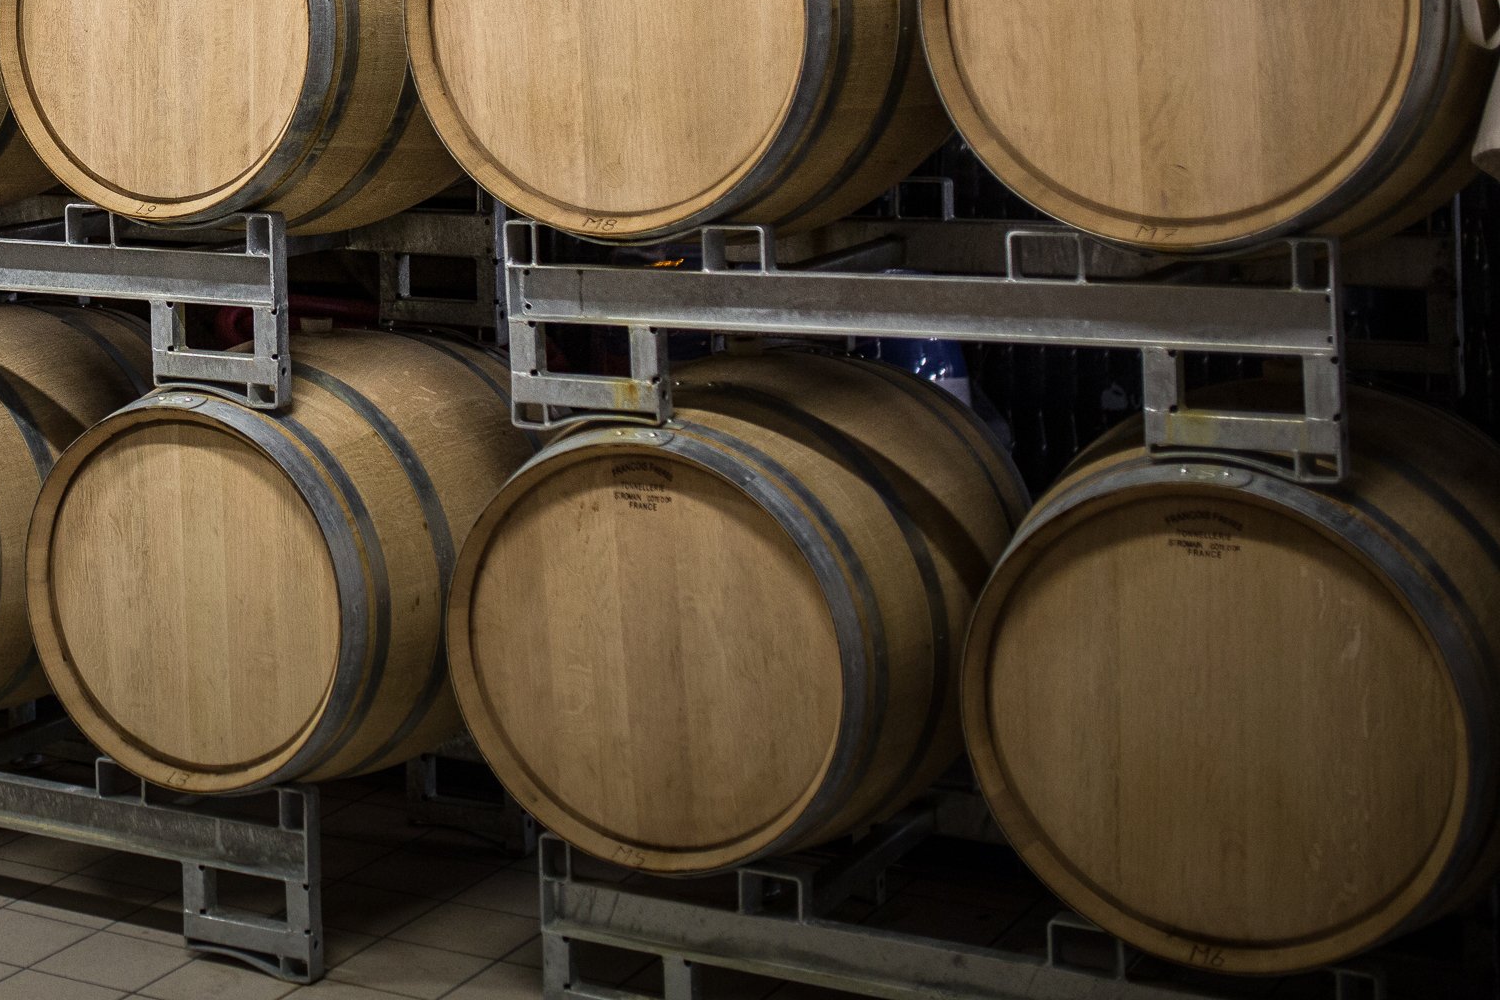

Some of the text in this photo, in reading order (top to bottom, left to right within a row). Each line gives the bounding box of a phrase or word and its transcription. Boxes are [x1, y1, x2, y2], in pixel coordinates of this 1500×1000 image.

[135, 203, 157, 216] L9
[582, 217, 618, 231] M8
[1135, 225, 1179, 242] M7
[628, 501, 658, 512] FRANCE
[1187, 548, 1222, 559] FRANCE
[167, 770, 190, 787] L3
[1189, 944, 1225, 967] M6
